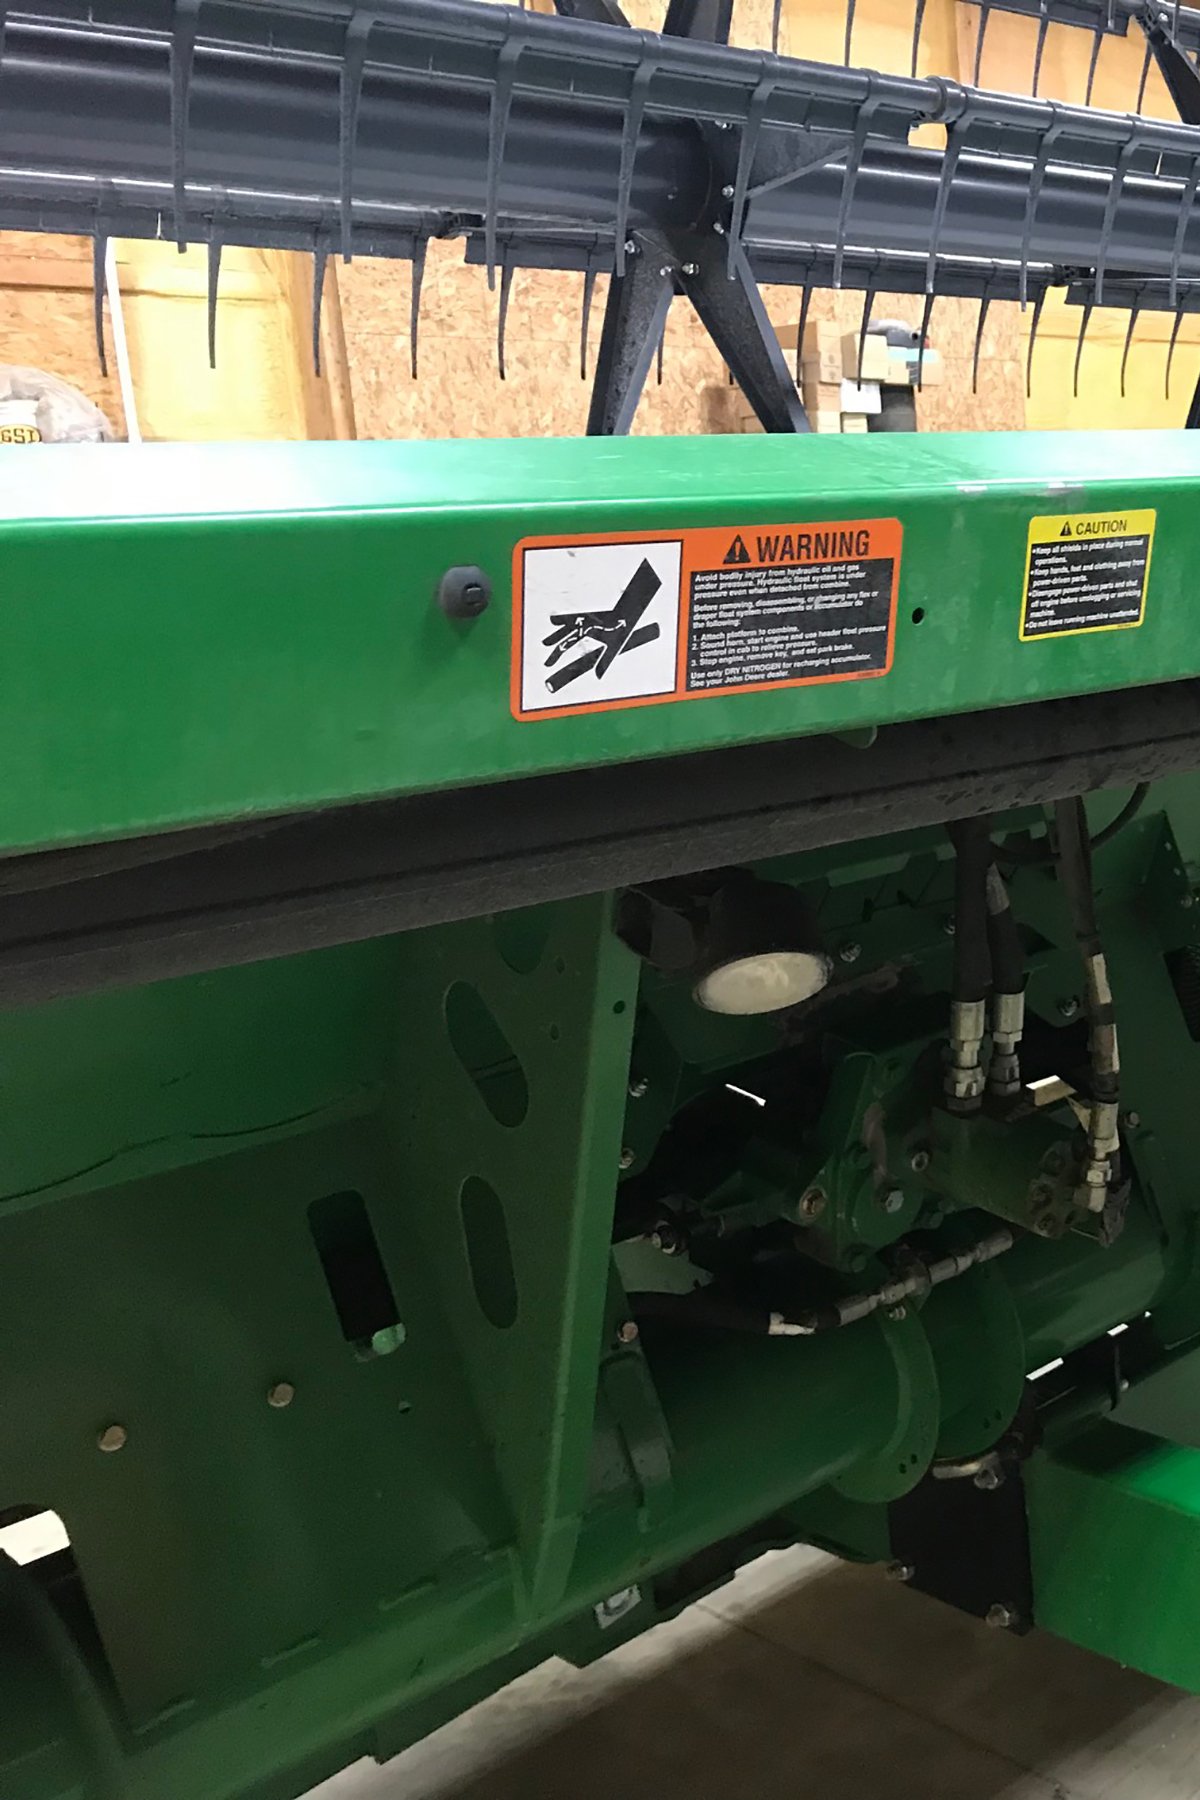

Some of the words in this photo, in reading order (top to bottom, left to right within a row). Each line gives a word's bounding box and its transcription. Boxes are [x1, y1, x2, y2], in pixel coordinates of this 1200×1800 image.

[1, 428, 36, 443] GSI
[1076, 520, 1128, 535] CAUTION
[757, 530, 869, 562] WARNING
[695, 574, 718, 582] Avoid
[719, 572, 743, 581] bodily
[745, 570, 767, 579] injury
[769, 568, 786, 576] from
[787, 567, 820, 577] hydraulic
[822, 565, 831, 573] oil
[695, 583, 717, 591] under
[757, 578, 792, 587] Hydraulic
[812, 574, 837, 582] system
[694, 591, 728, 601] pressure
[770, 585, 802, 593] detached
[701, 632, 725, 641] Attach
[726, 630, 757, 639] platform
[707, 670, 723, 678] only
[725, 667, 741, 675] DRY
[742, 663, 781, 673] NITROGEN
[793, 658, 830, 667] recharging
[690, 680, 705, 688] See
[706, 679, 722, 687] your
[724, 675, 743, 683] John
[744, 673, 765, 681] Deere
